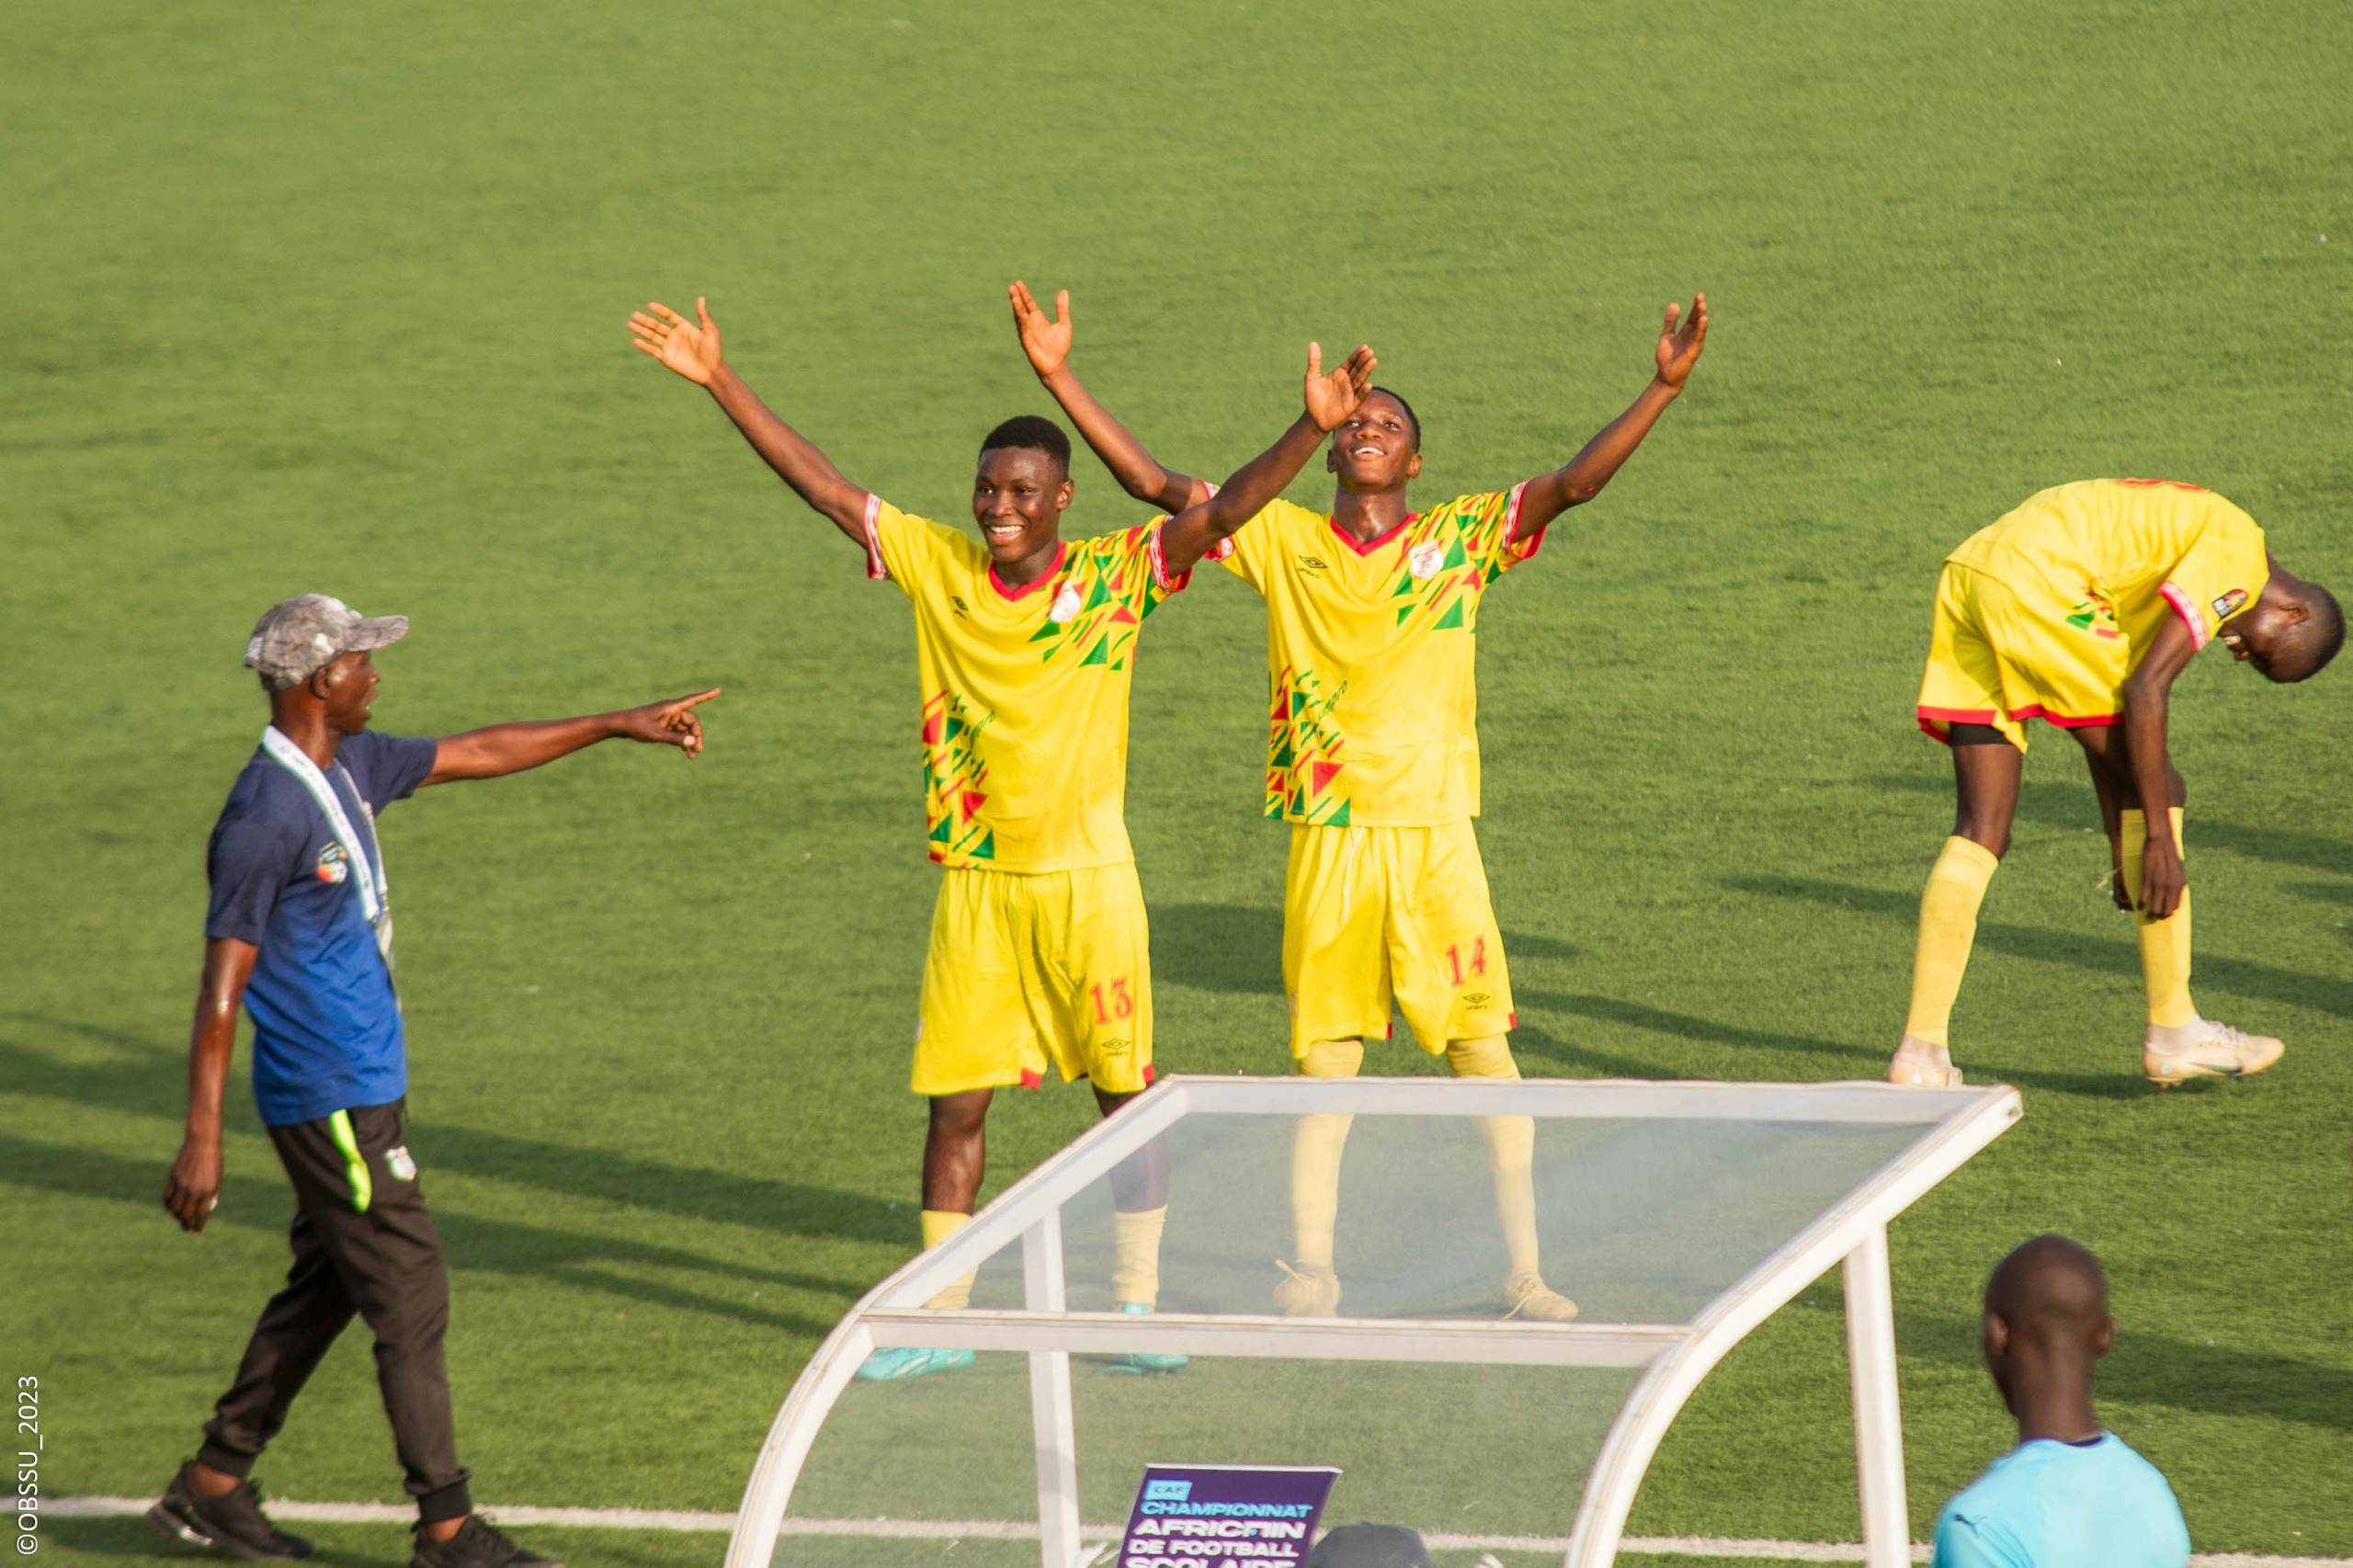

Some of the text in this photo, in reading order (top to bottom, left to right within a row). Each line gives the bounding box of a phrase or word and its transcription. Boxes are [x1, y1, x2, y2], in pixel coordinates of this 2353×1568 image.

[1446, 935, 1486, 987] 14
[1089, 975, 1132, 1025] 13
[1154, 1485, 1188, 1494] CAF
[1141, 1501, 1313, 1517] CHAMPIONNAT
[1133, 1518, 1307, 1539] AFRICAIN
[1128, 1539, 1300, 1557] DE FOOTBALL
